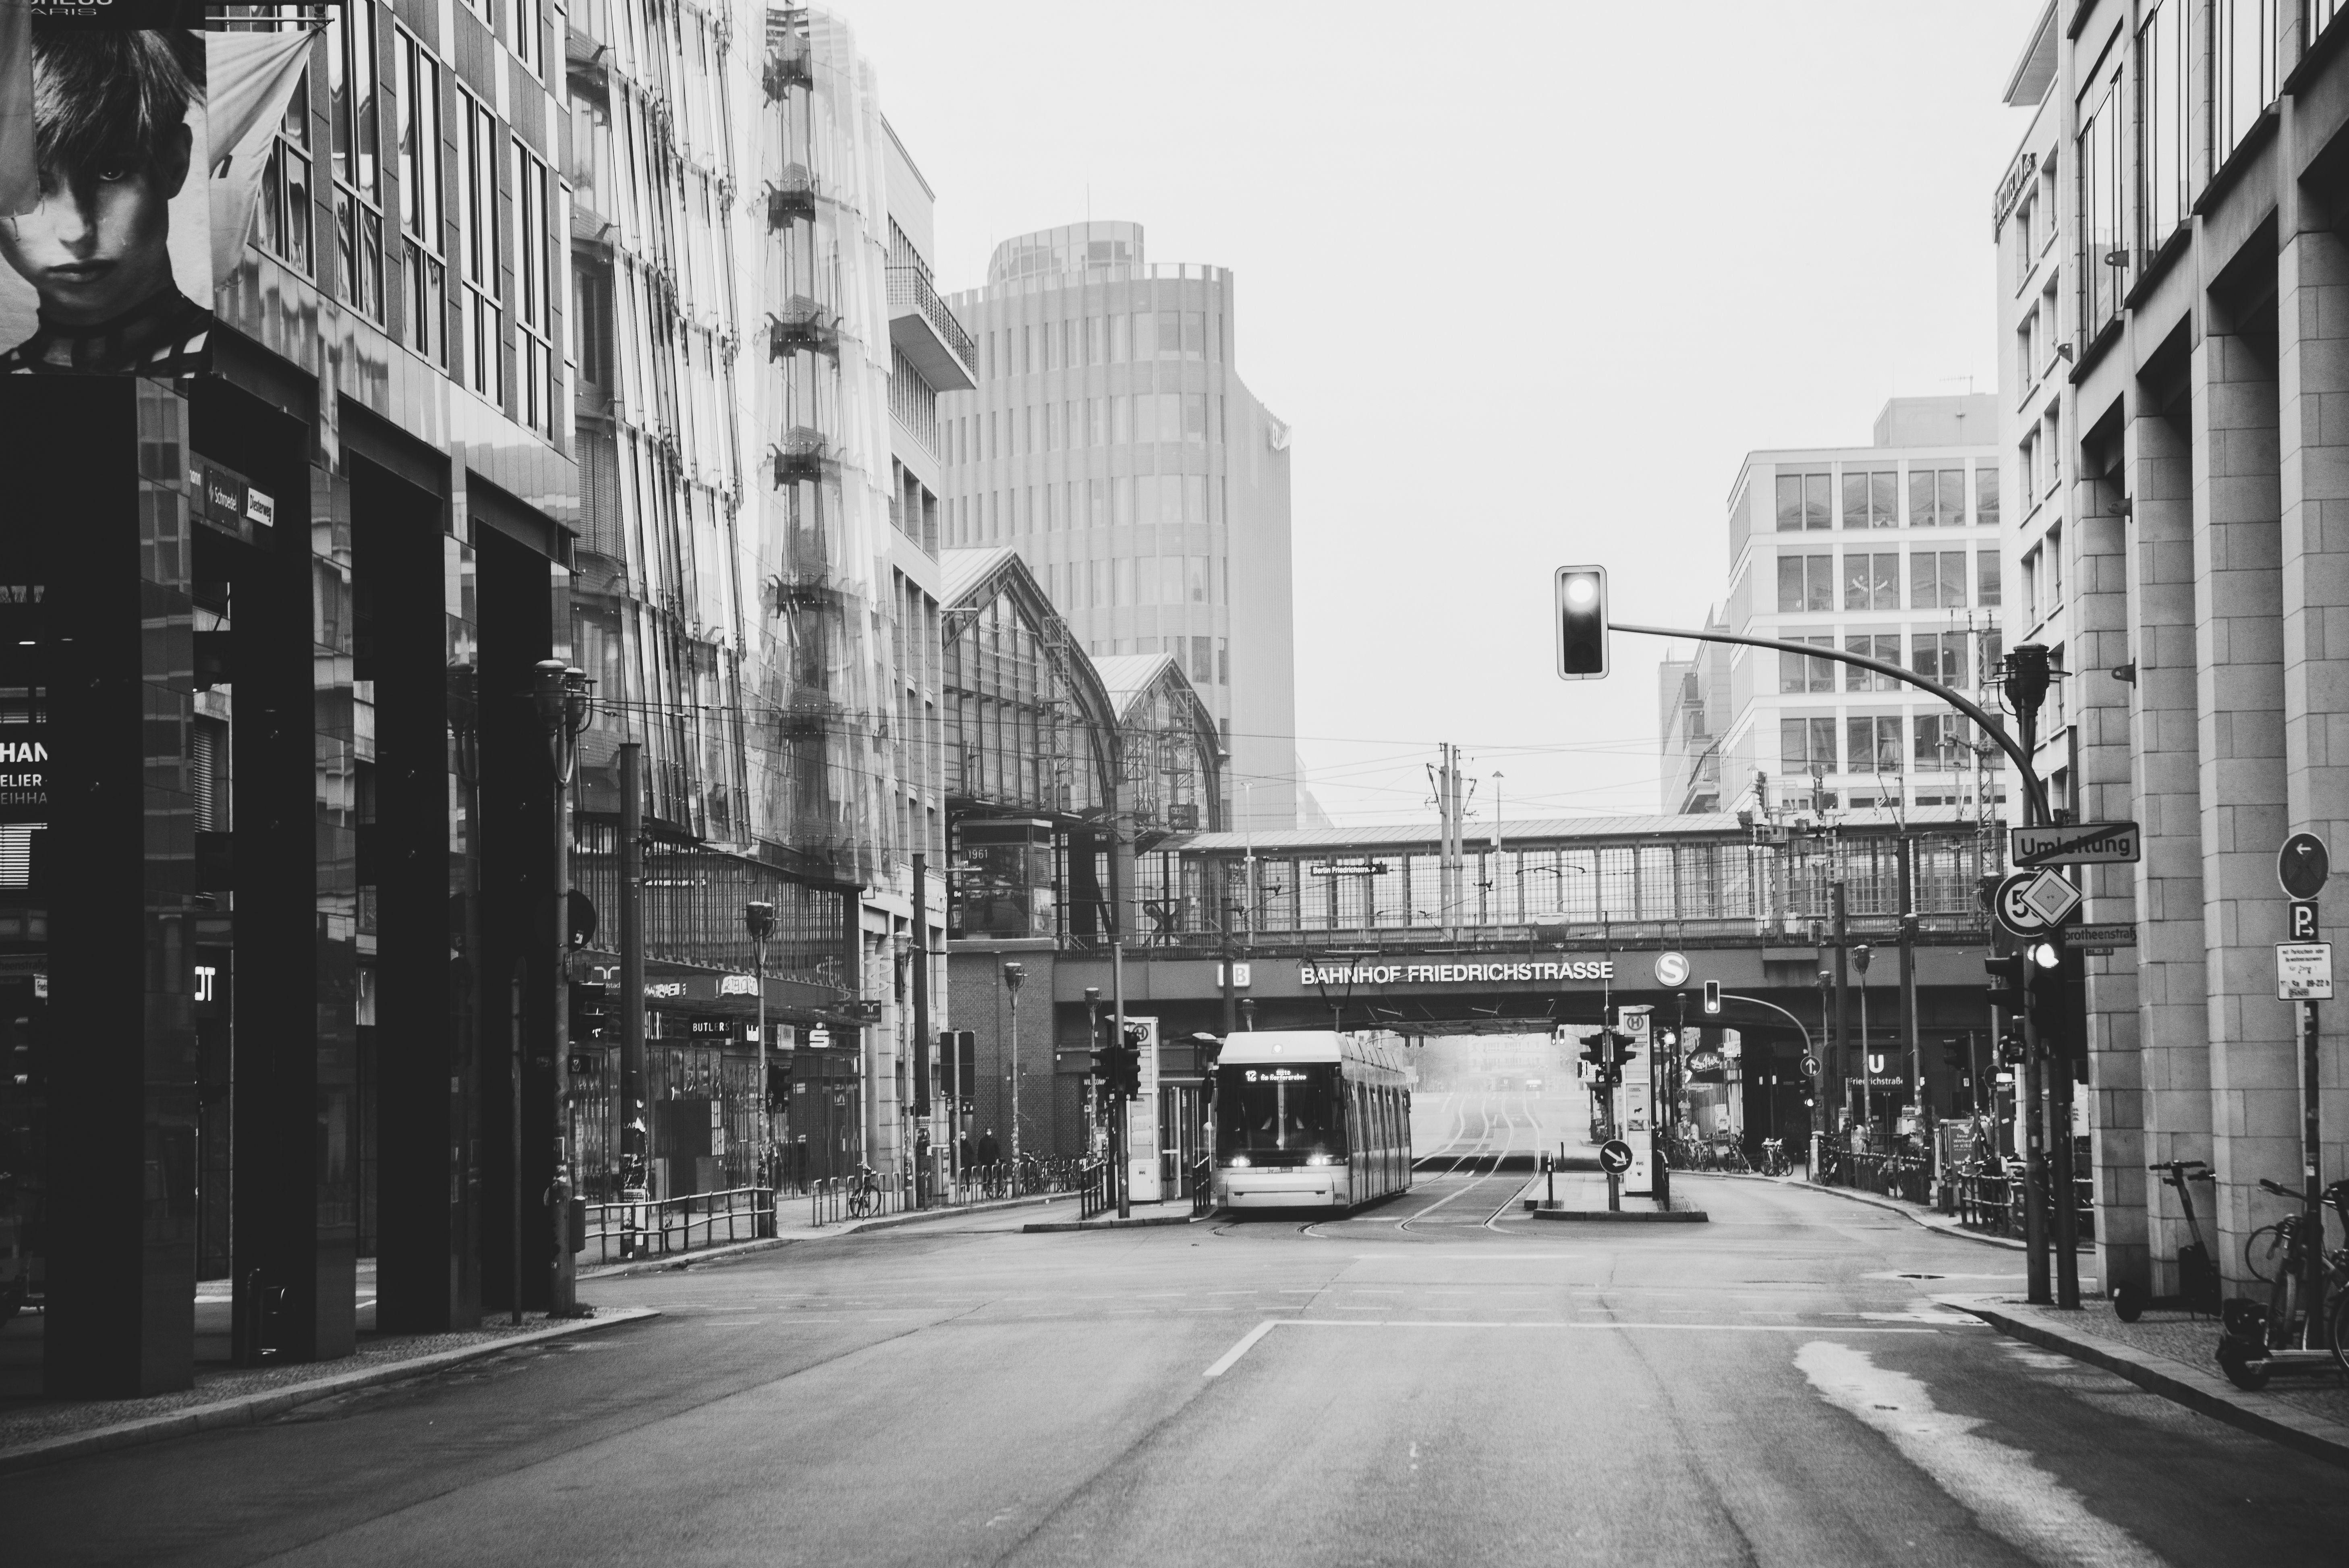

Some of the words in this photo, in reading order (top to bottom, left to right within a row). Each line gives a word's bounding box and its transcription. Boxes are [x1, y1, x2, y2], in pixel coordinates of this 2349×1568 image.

[215, 487, 236, 512] Schroedel
[250, 495, 271, 522] Diesterweg
[0, 774, 41, 787] ELIER
[1, 792, 47, 804] EIHHA
[968, 849, 987, 859] 1961
[2021, 836, 2129, 856] Umleitung
[2013, 890, 2039, 918] 5
[2295, 906, 2312, 936] P
[1301, 965, 1401, 985] BAHNHOF
[1408, 961, 1613, 982] FRIEDRICHSTRASSE
[1660, 955, 1684, 984] S
[693, 1022, 730, 1032] BUTLERS
[1868, 1054, 1884, 1073] U
